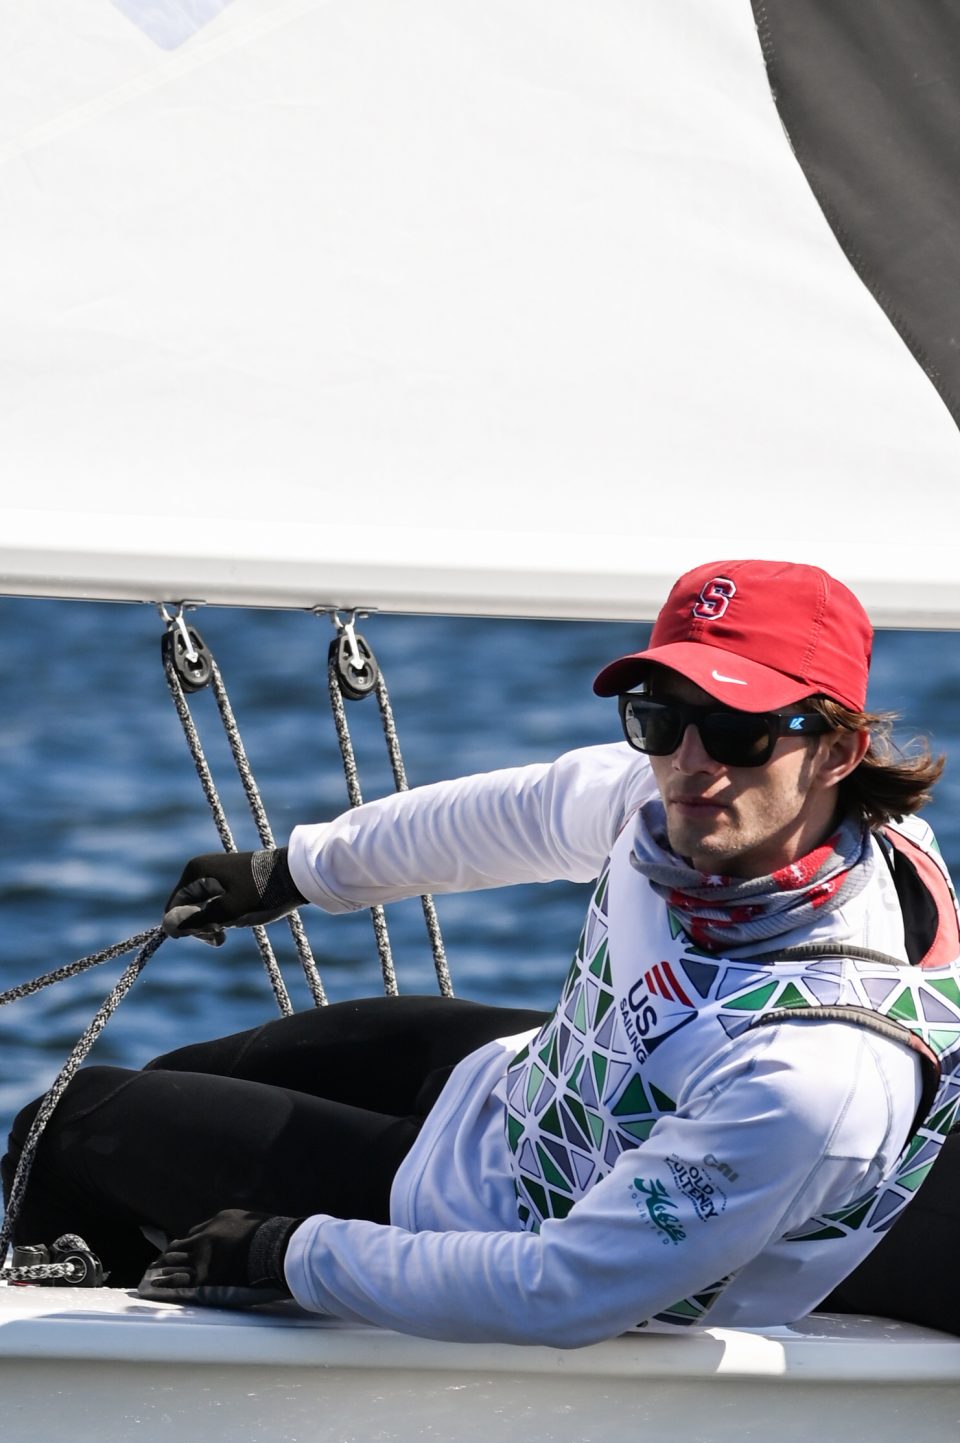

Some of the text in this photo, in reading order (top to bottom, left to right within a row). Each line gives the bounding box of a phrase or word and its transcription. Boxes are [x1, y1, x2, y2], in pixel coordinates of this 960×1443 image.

[692, 577, 736, 621] S
[620, 997, 648, 1066] SAILING
[689, 1166, 715, 1196] OLD
